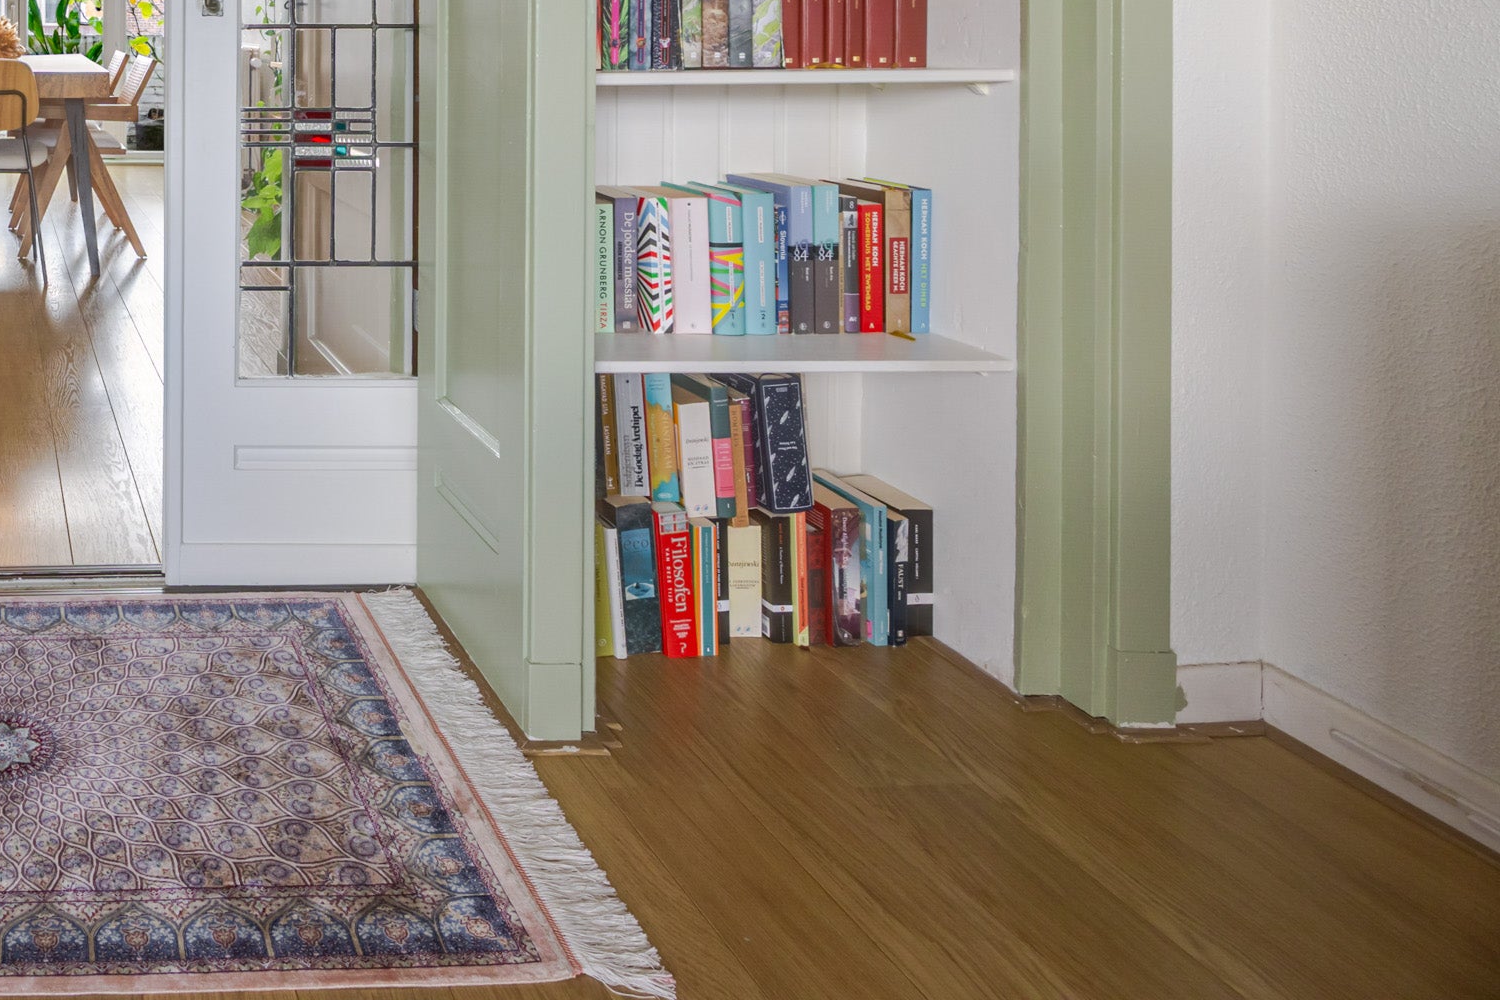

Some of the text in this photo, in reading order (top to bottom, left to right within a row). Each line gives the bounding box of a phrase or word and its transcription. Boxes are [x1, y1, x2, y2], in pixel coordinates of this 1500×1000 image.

[621, 212, 635, 309] De joodse messias
[779, 230, 787, 260] Slovenia
[793, 250, 809, 262] 84
[818, 250, 834, 262] 84
[598, 208, 608, 329] ARNON GRUNBERG TIRZA
[630, 406, 644, 488] De Goelag Archipel
[662, 412, 673, 469] SHANTARAM
[624, 538, 649, 549] eco
[671, 536, 691, 613] Filosofen
[897, 563, 905, 589] FAUST
